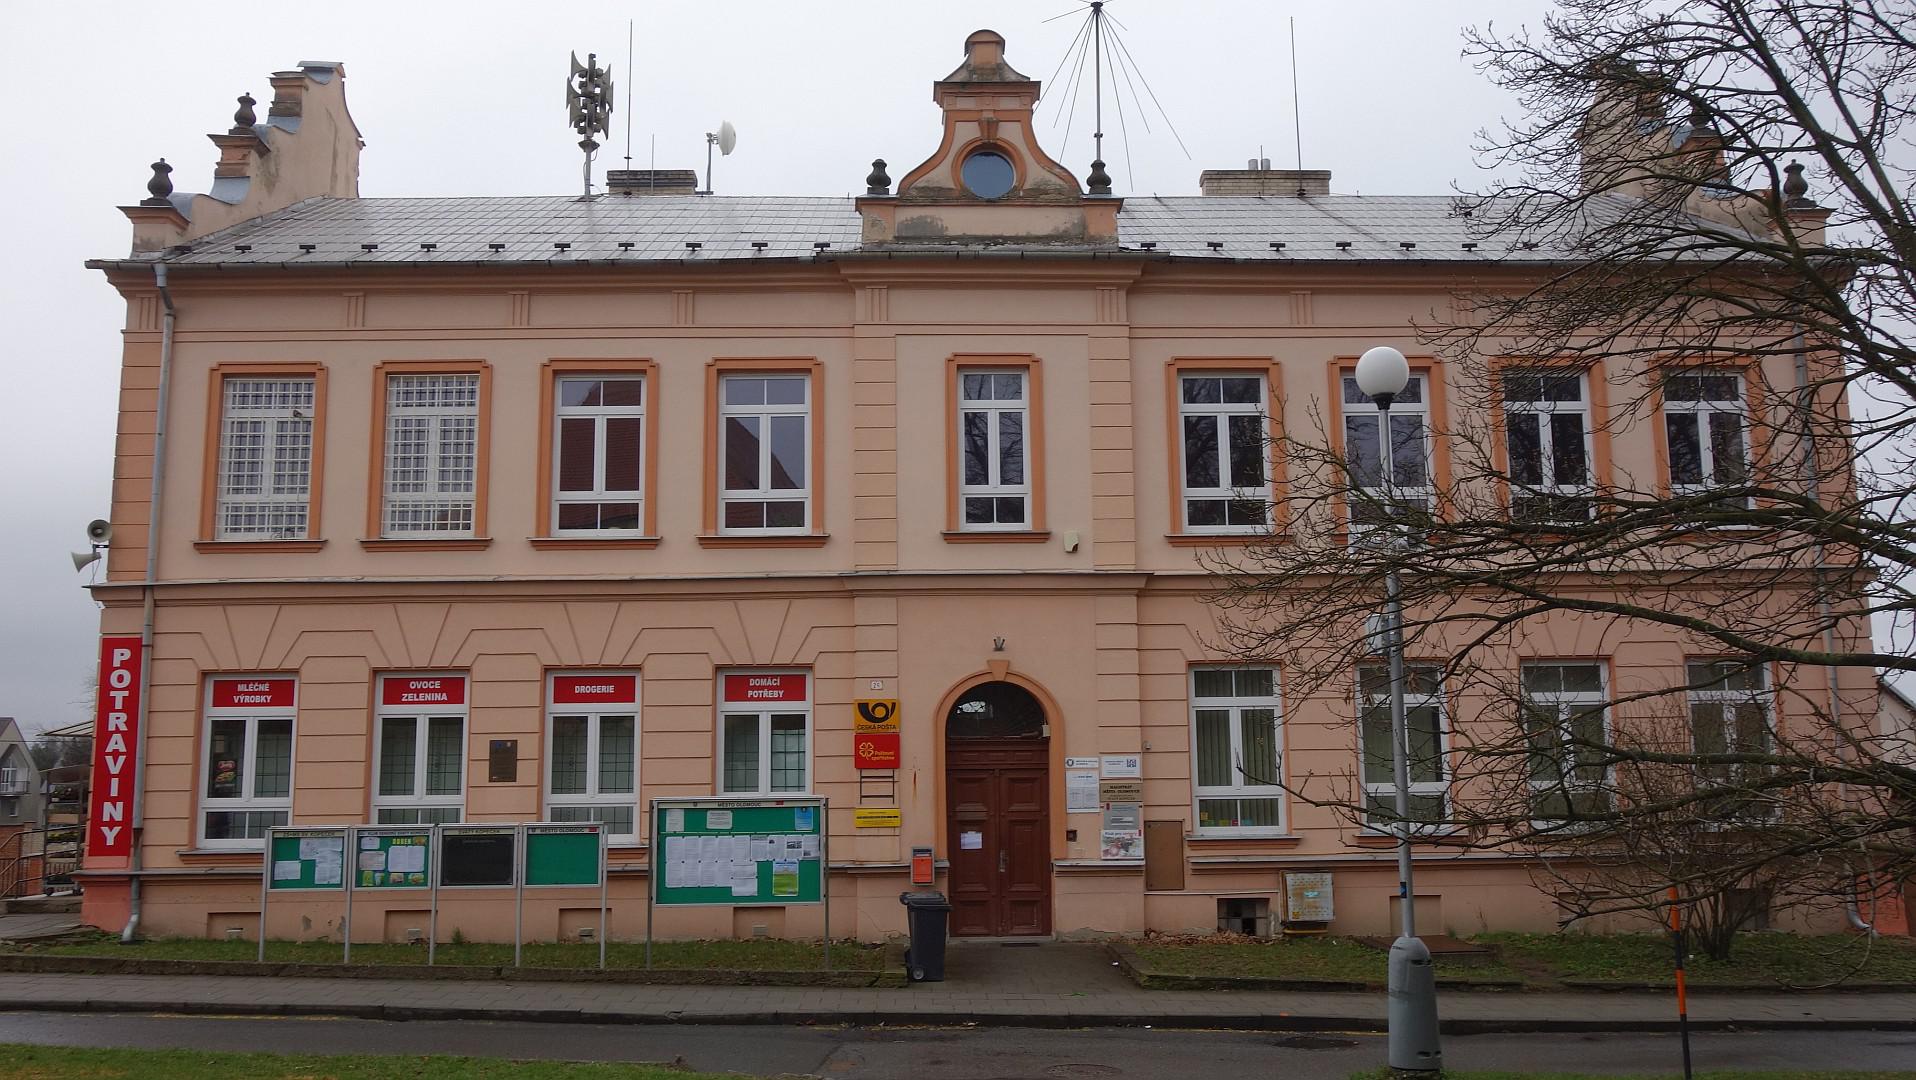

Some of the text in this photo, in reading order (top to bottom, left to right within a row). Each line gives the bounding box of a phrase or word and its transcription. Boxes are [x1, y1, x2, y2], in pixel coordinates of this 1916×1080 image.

[409, 681, 441, 689] OVOCE
[749, 677, 780, 686] DOMÁCÍ
[237, 682, 270, 692] MLÉČNÉ
[574, 685, 615, 694] DROGERIE
[401, 693, 448, 702] ZELENINA
[747, 689, 784, 698] POTŘEBY
[233, 694, 272, 703] VÝROBKY
[100, 648, 132, 846] POTRAVINY
